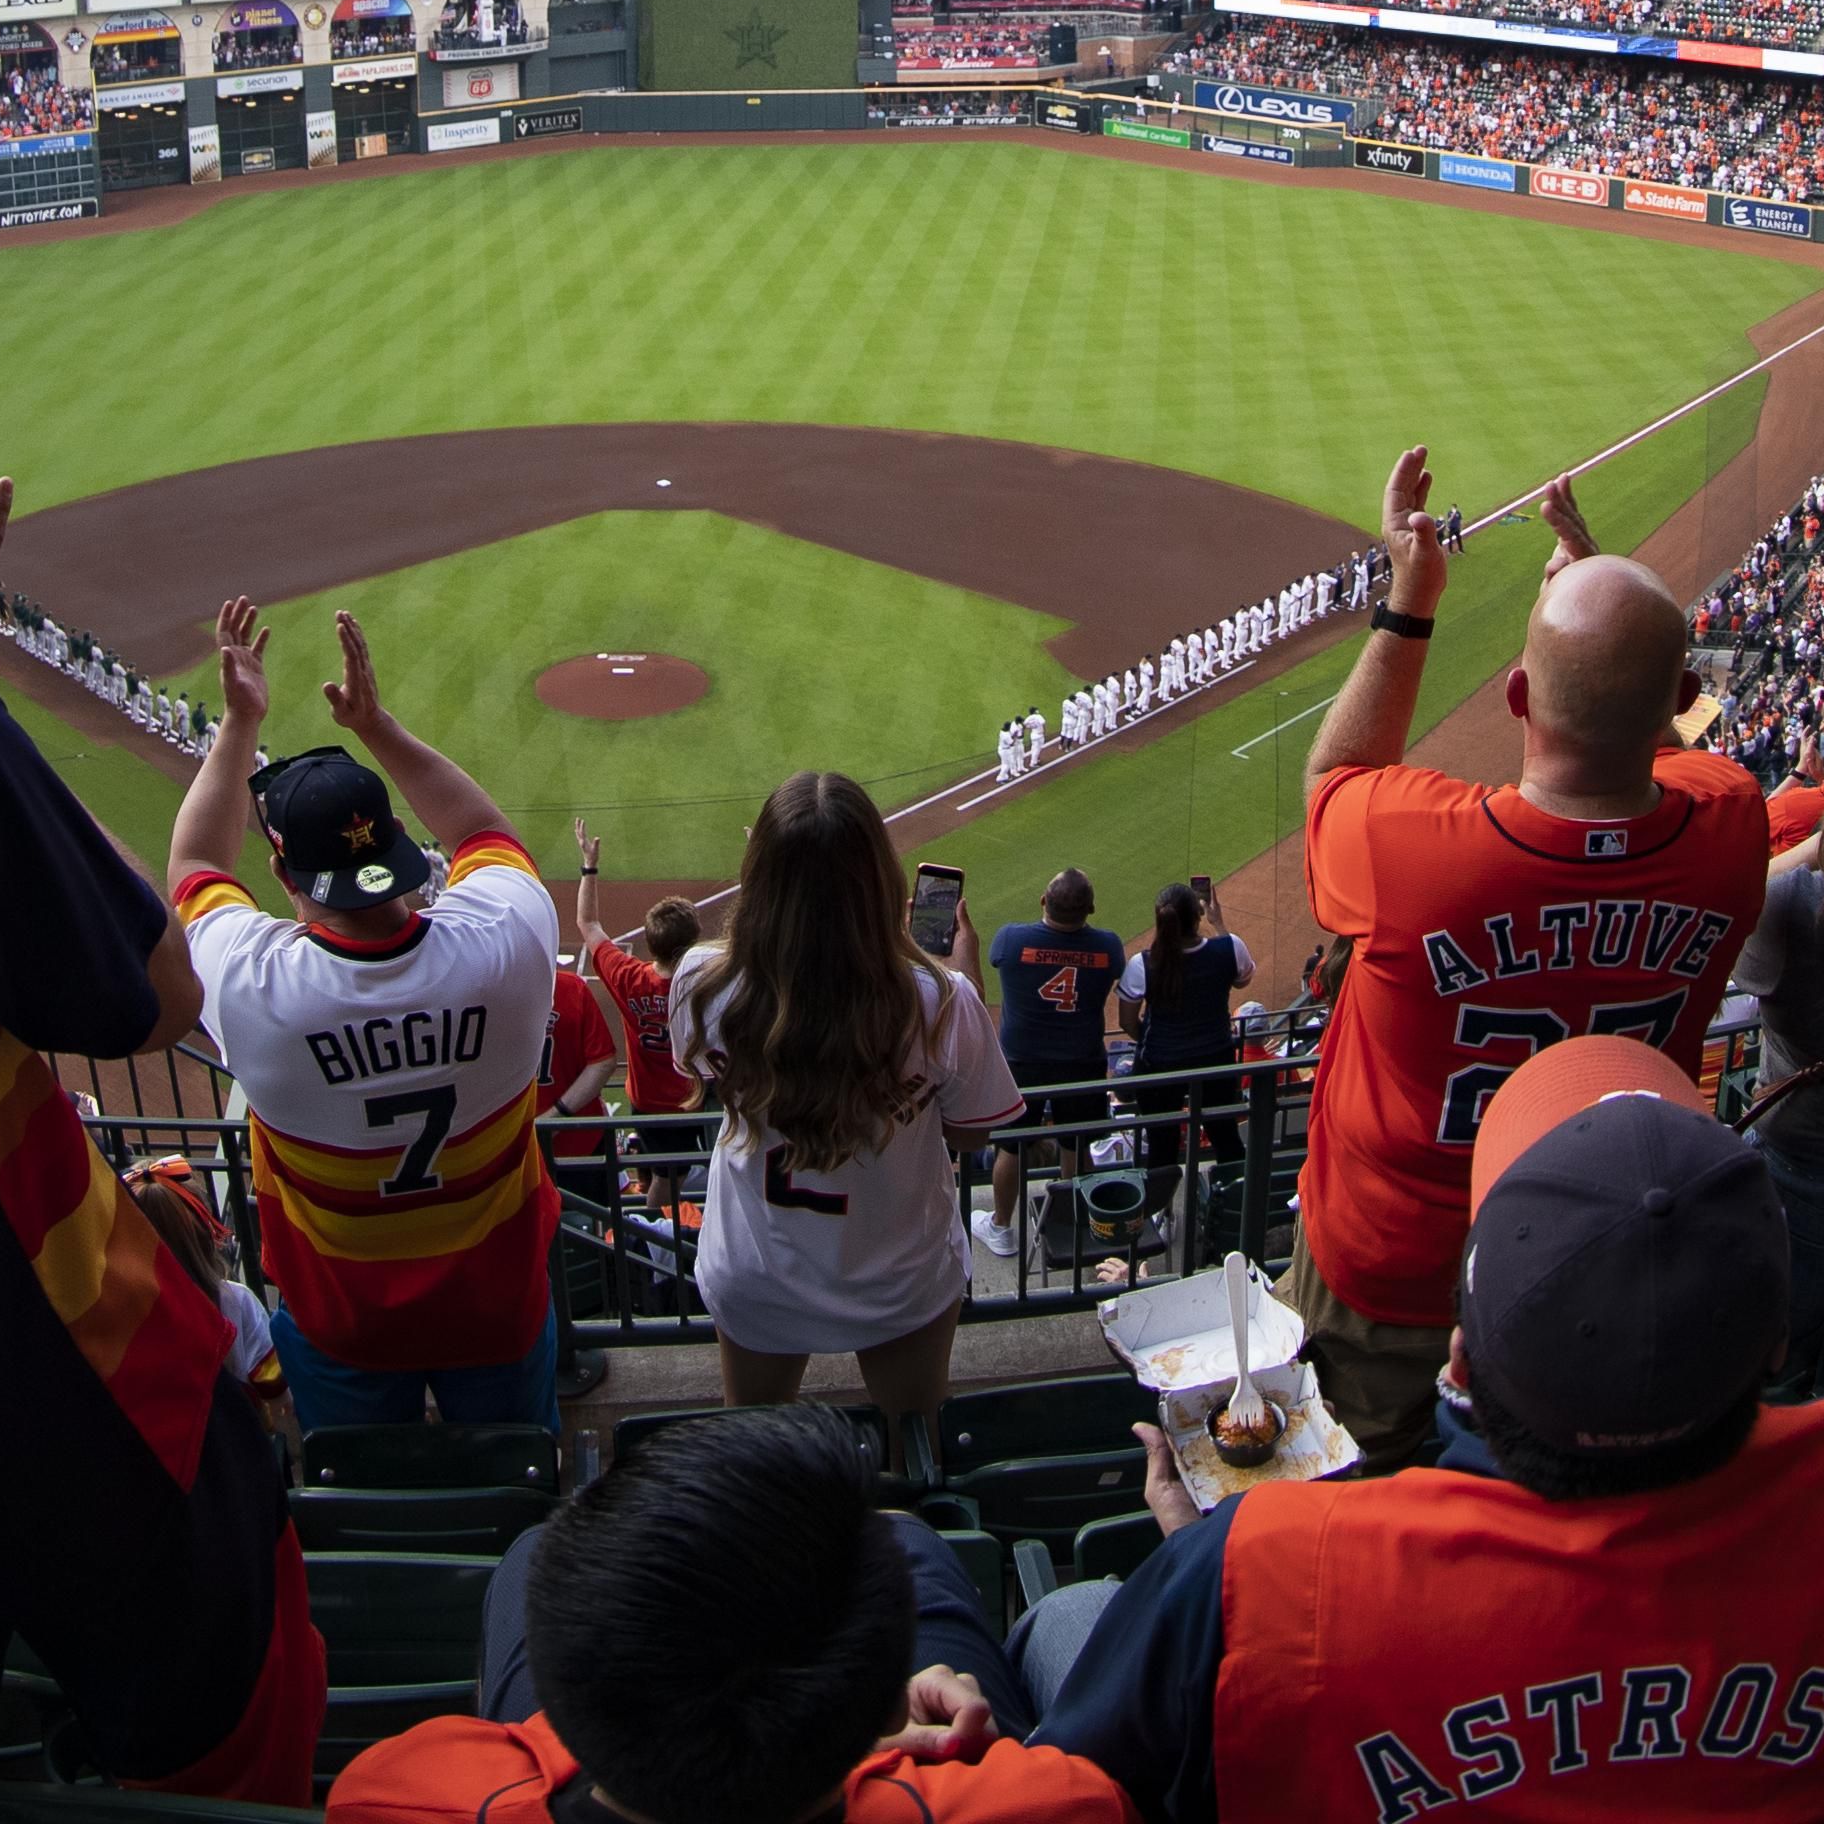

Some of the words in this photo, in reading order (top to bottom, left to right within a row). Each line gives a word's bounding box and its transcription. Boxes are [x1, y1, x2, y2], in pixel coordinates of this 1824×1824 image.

[246, 7, 276, 18] planet
[104, 19, 144, 32] Crawford
[249, 15, 283, 27] fitness
[939, 57, 994, 69] Budweiser
[247, 74, 288, 89] securian
[471, 80, 489, 94] 66
[99, 95, 120, 104] BANK
[130, 90, 165, 100] AMERICA
[1246, 95, 1333, 122] LEXUS
[530, 113, 578, 128] VERITEX
[309, 128, 334, 140] WM
[444, 123, 489, 139] Insperity
[1282, 128, 1301, 139] 370
[192, 143, 217, 155] WM
[1366, 146, 1412, 171] xfinity
[1454, 164, 1512, 183] HONDA
[1, 203, 82, 227] NITTOTIRE.COM
[1755, 208, 1795, 221] ENERGY
[1755, 217, 1804, 234] TRANSFER
[1422, 899, 1734, 997] ALTUVE
[1034, 949, 1096, 967] SPRINGER
[1038, 966, 1078, 1013] 4
[628, 994, 669, 1016] ALT
[305, 1004, 488, 1087] BIGGIO
[364, 1083, 457, 1200] 7
